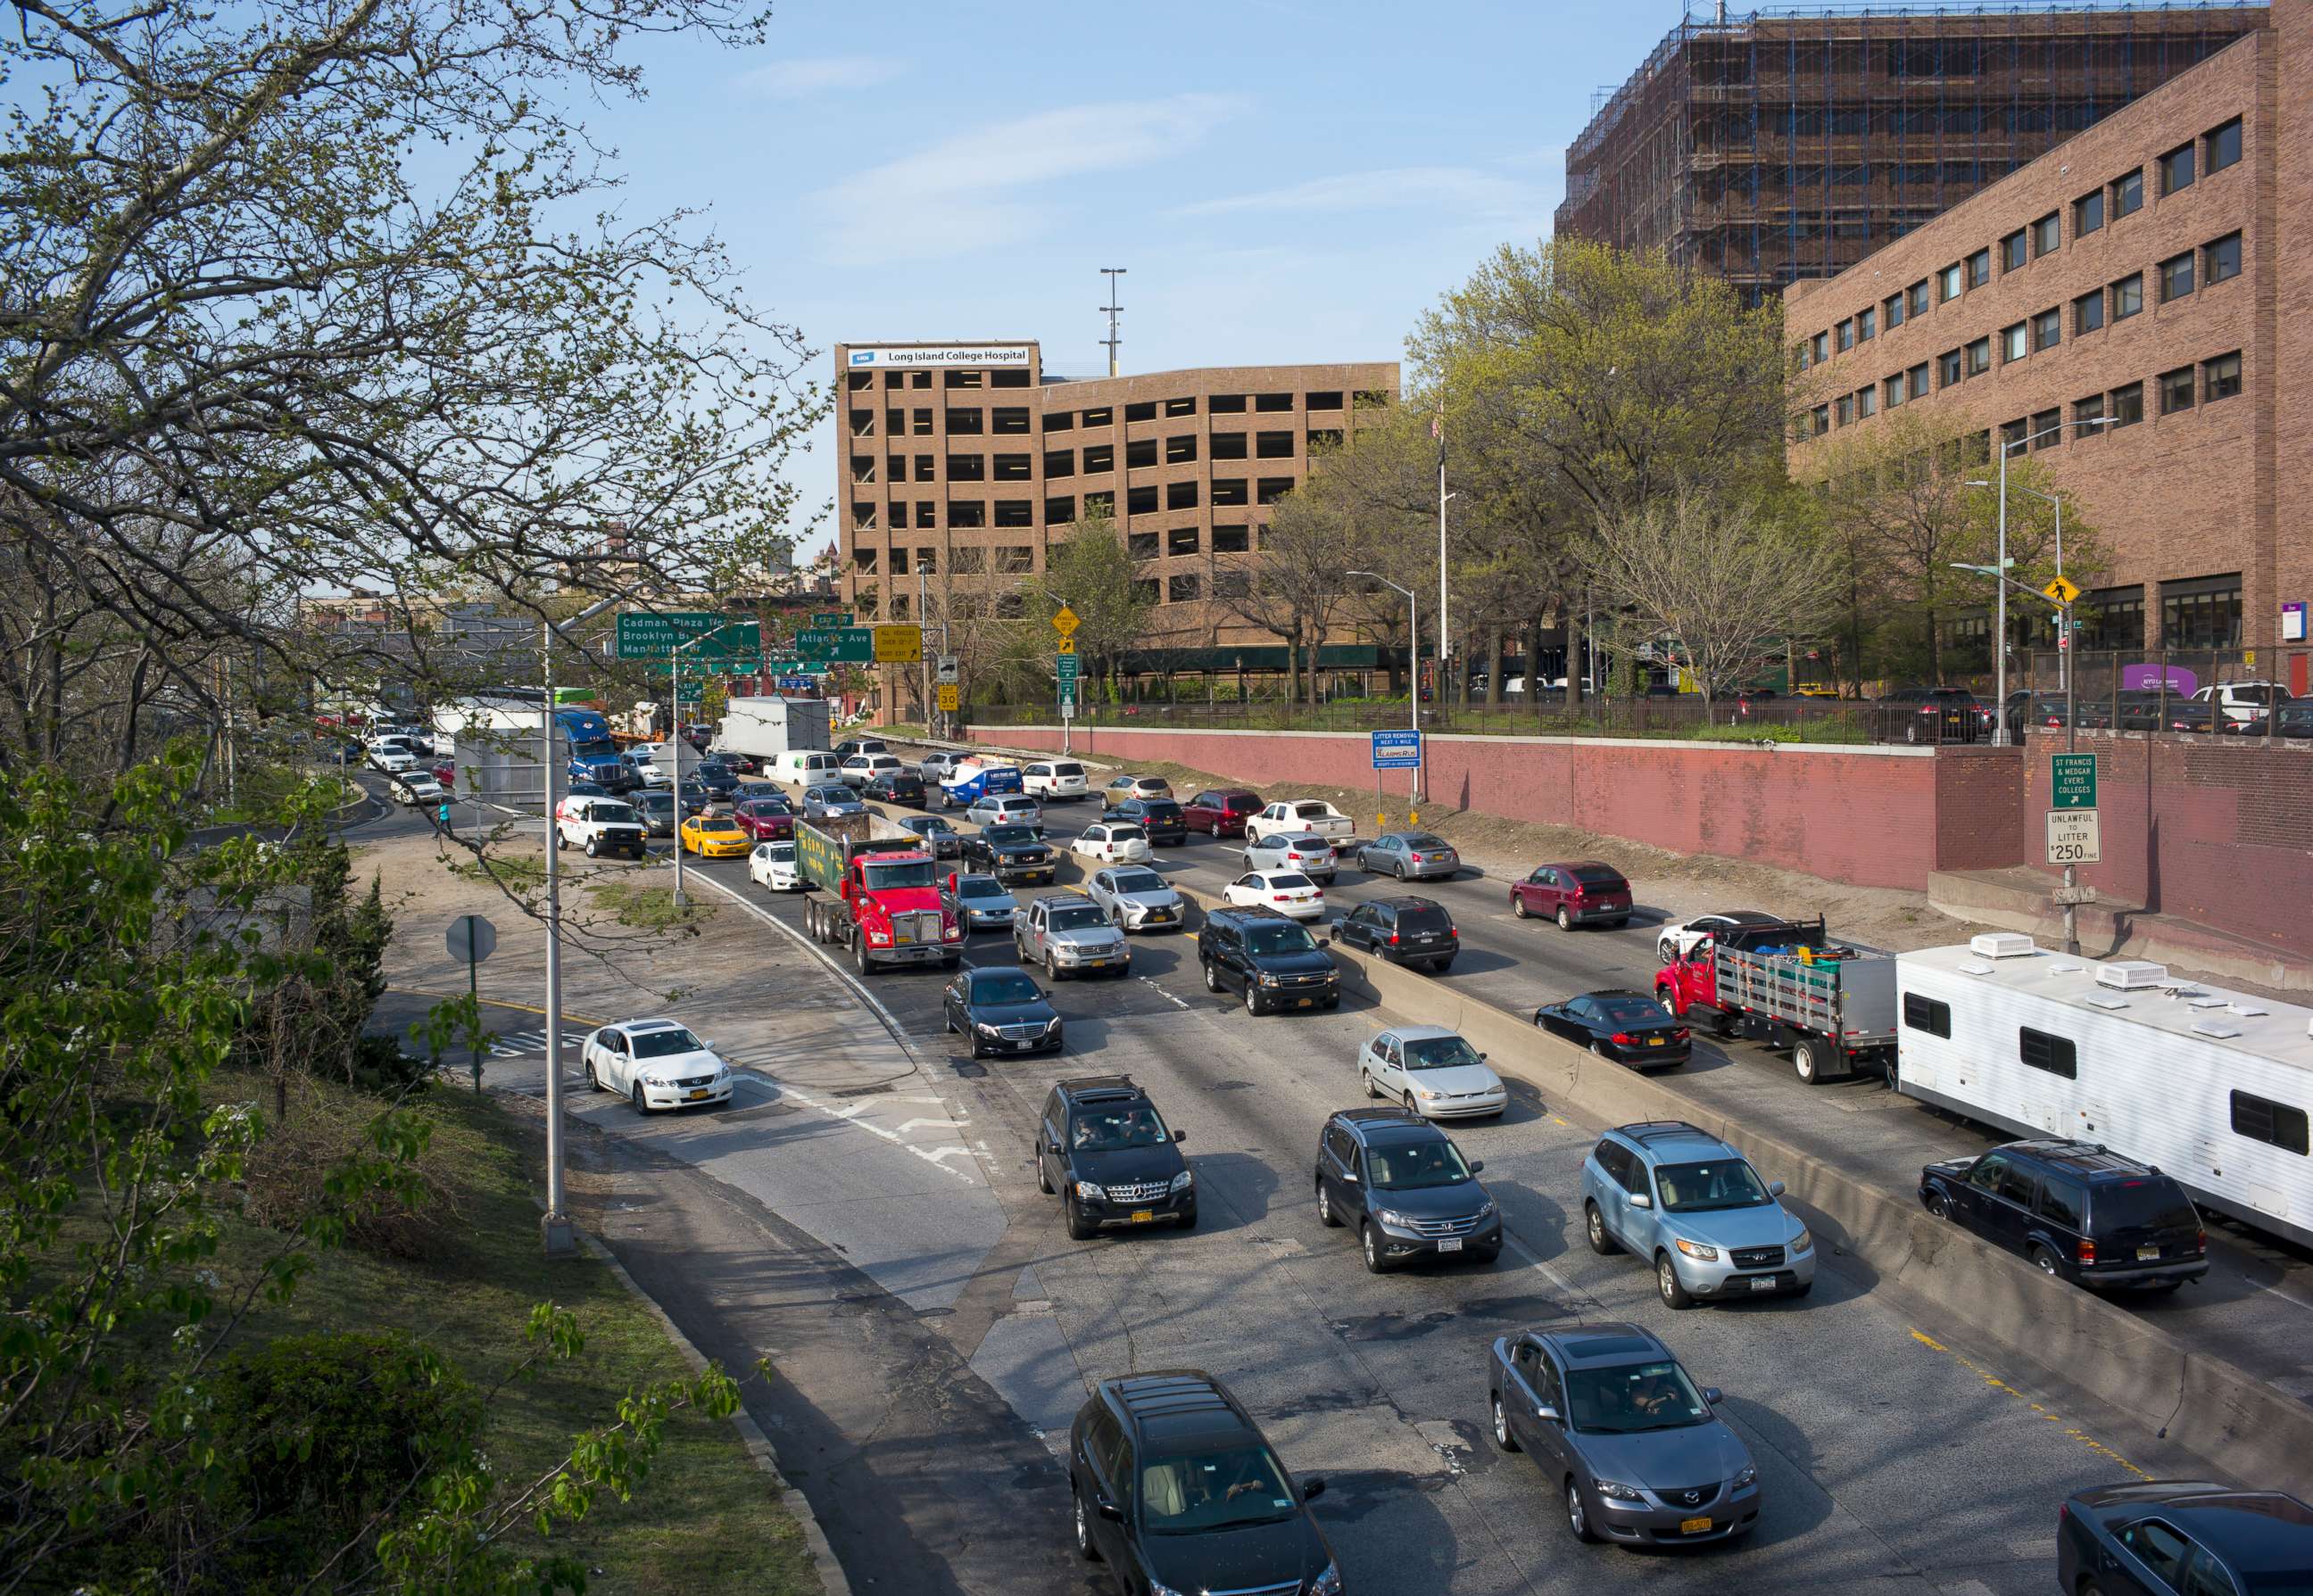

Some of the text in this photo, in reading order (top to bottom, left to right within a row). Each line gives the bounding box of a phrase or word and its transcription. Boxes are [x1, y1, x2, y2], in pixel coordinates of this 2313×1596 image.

[889, 351, 1025, 362] Long Island College Hospital
[623, 618, 668, 627] Cadman
[623, 632, 673, 641] Brooklyn
[800, 634, 867, 643] Atlanc Ave
[941, 696, 956, 704] 30
[2052, 814, 2093, 823] UNLAWFUL
[2058, 832, 2088, 841] LITTER
